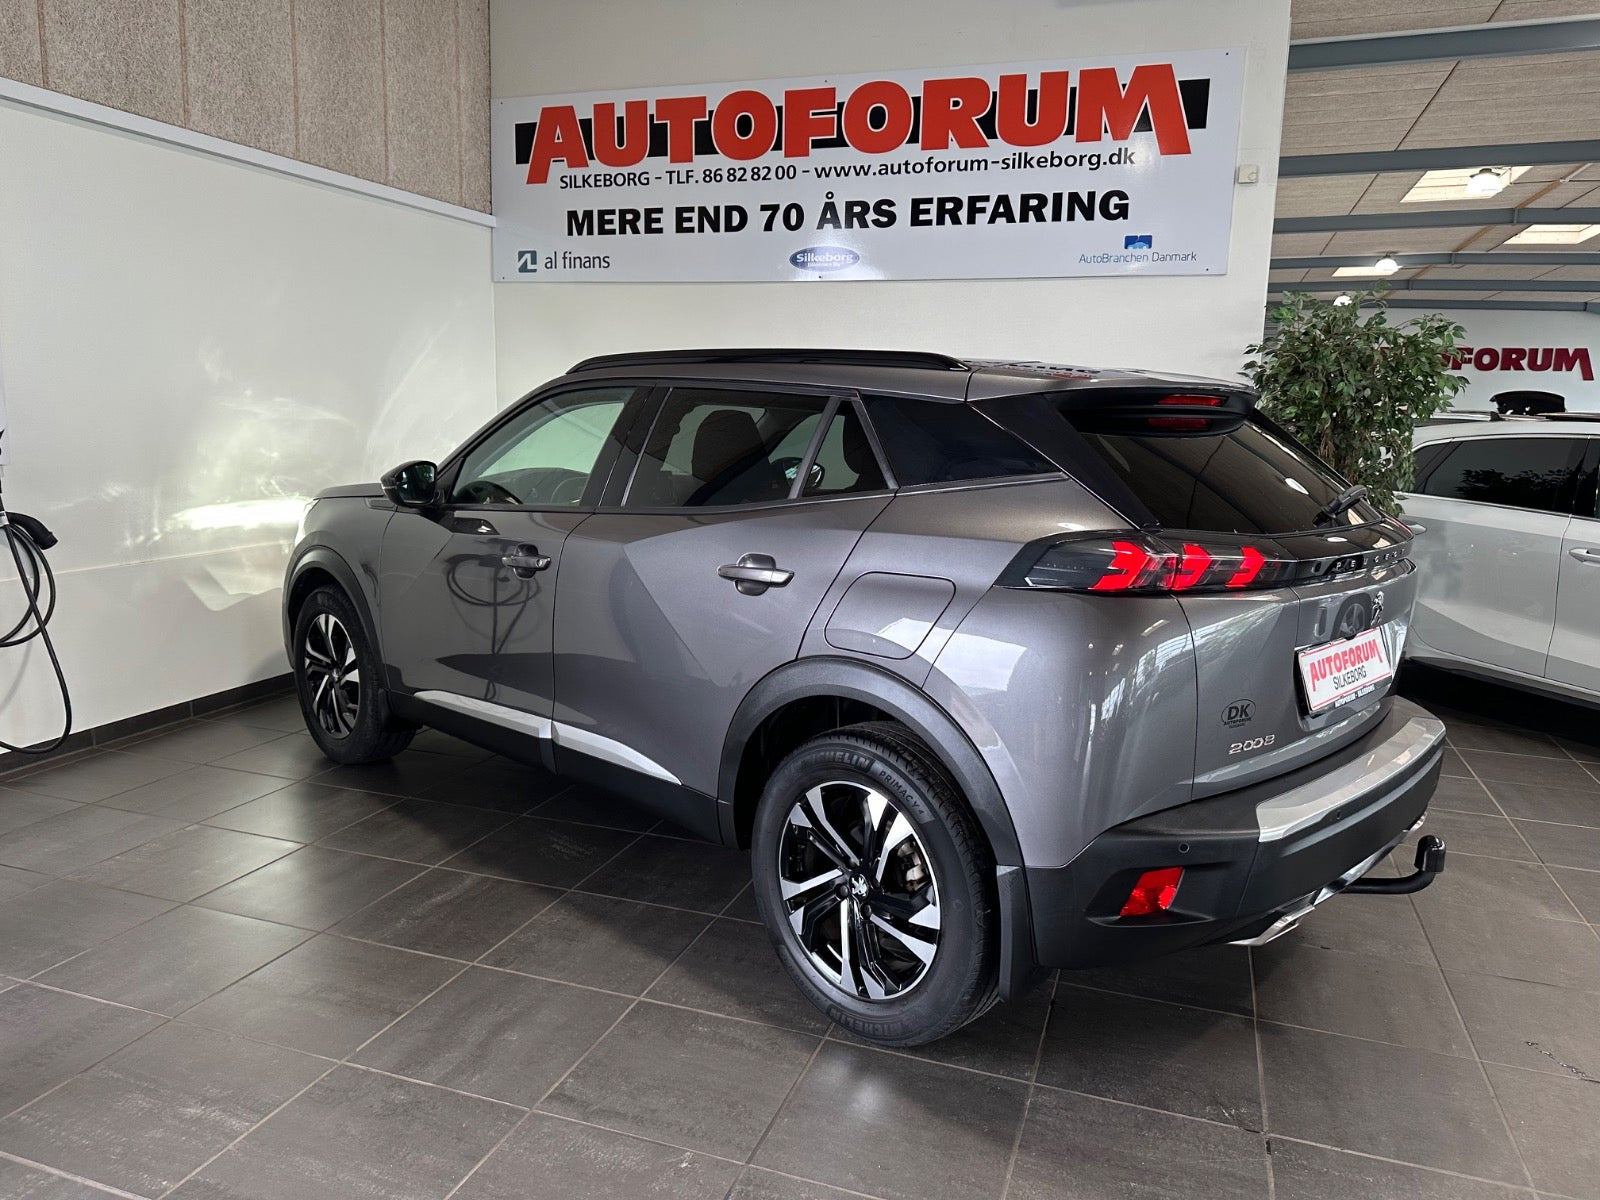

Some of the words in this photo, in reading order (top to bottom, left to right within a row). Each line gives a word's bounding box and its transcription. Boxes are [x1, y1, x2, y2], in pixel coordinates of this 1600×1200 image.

[526, 64, 1191, 184] AUTOFORUM
[560, 172, 650, 190] SILKEBORG
[666, 170, 699, 185] TLF.
[813, 148, 1136, 179] www.autoforum-silkeborg.dk
[567, 208, 663, 236] MERE
[675, 205, 748, 234] END
[759, 203, 804, 232] 70
[817, 191, 897, 230] ÅRS
[910, 190, 1130, 227] ERFARING
[544, 251, 557, 270] al
[562, 250, 611, 270] finans
[796, 252, 854, 264] Silkeborg
[1079, 253, 1149, 265] AutoBranchen
[1151, 251, 1198, 262] Danmark
[1440, 347, 1594, 381] FORUM
[1309, 639, 1383, 692] AUTOFORUM
[1333, 665, 1367, 690] SILKEBORG
[1228, 703, 1251, 720] DK
[1229, 734, 1275, 755] 2008
[803, 751, 870, 769] ICHELIN
[880, 770, 920, 807] PRIMACY
